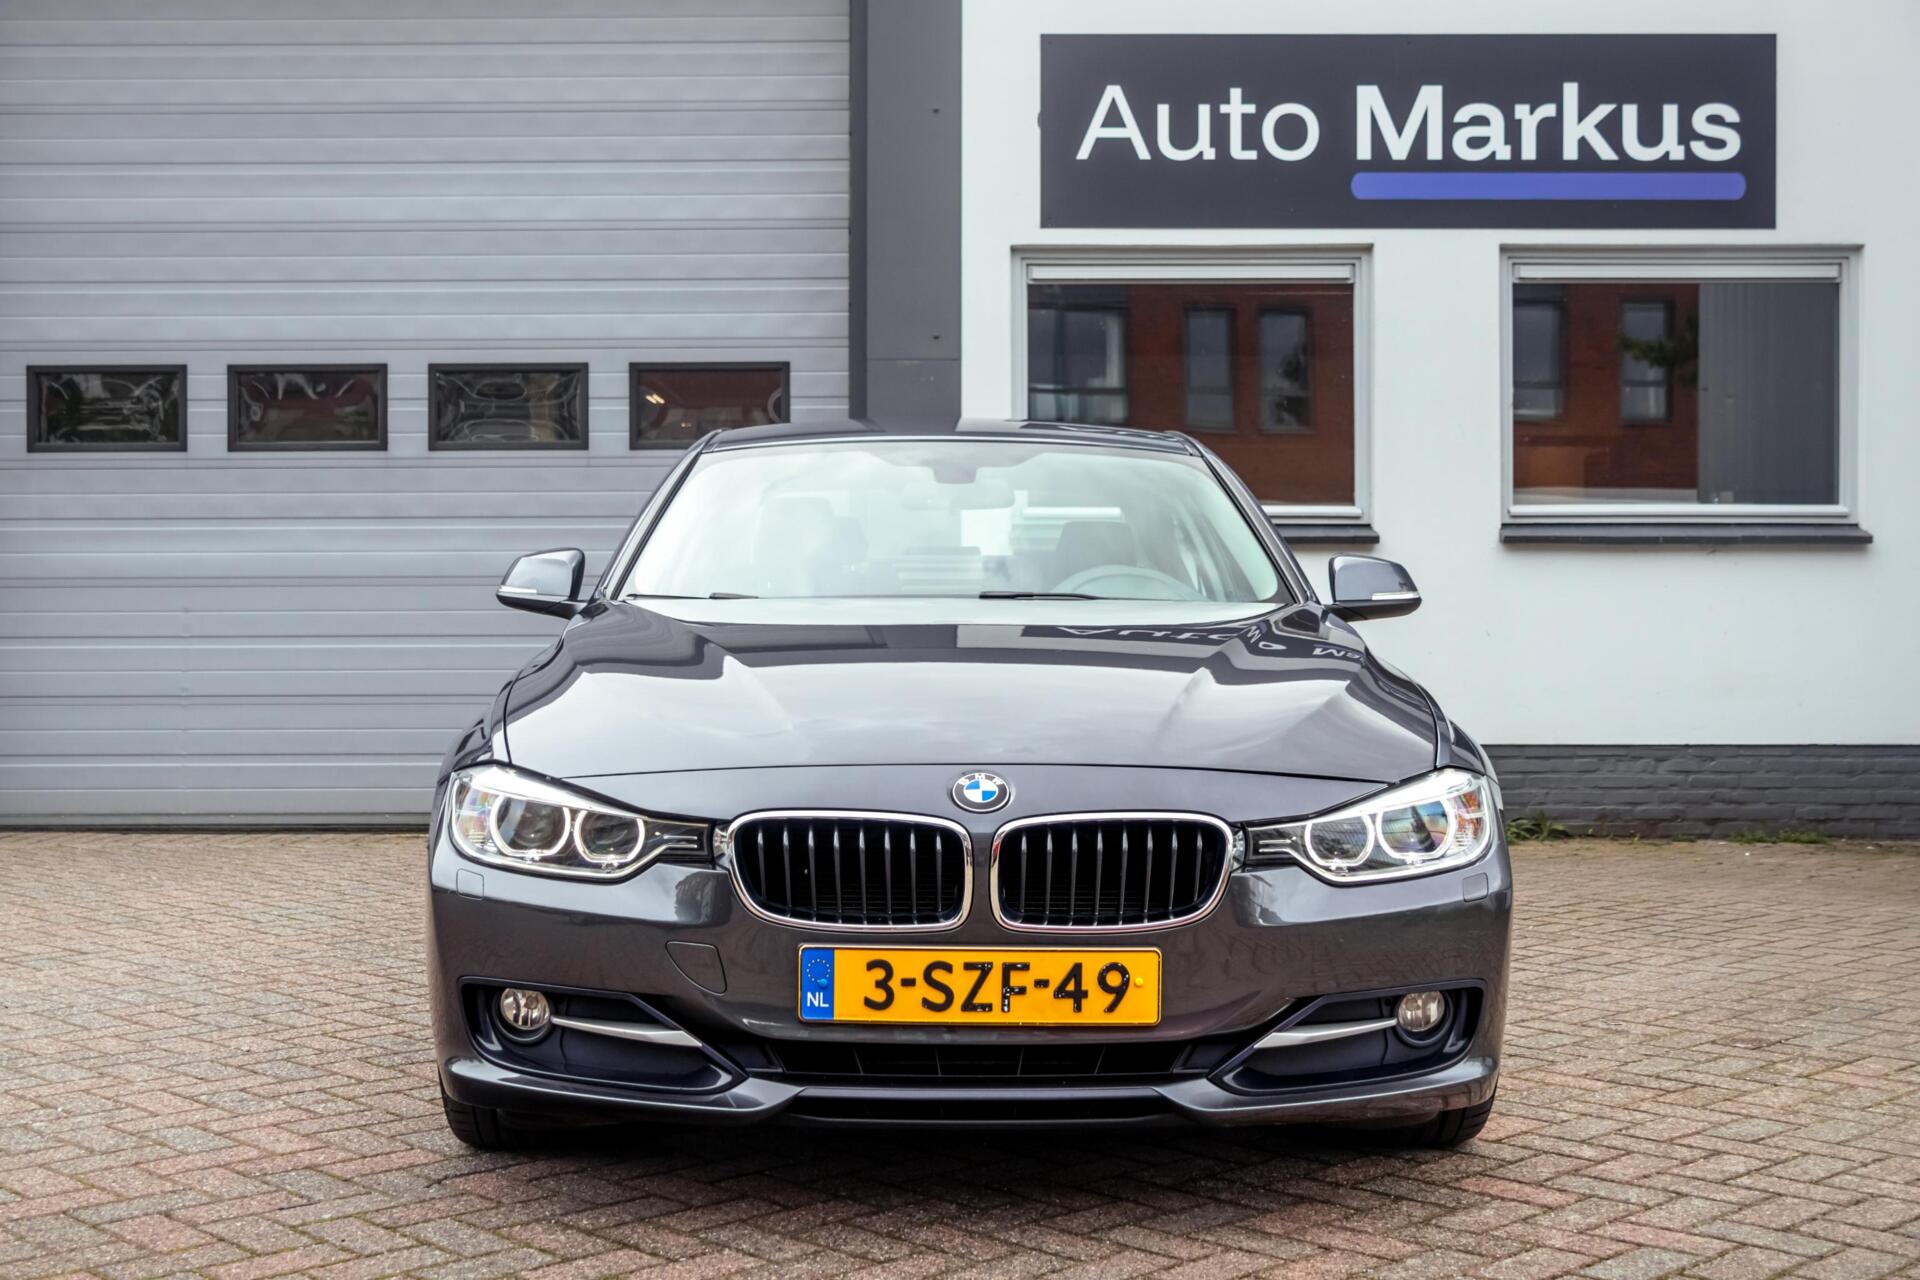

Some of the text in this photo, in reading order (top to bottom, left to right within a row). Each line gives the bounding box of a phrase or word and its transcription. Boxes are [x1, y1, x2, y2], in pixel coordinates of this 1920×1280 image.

[1075, 82, 1741, 162] Auto Markus
[806, 959, 1131, 1014] NL 3-SZF-49
